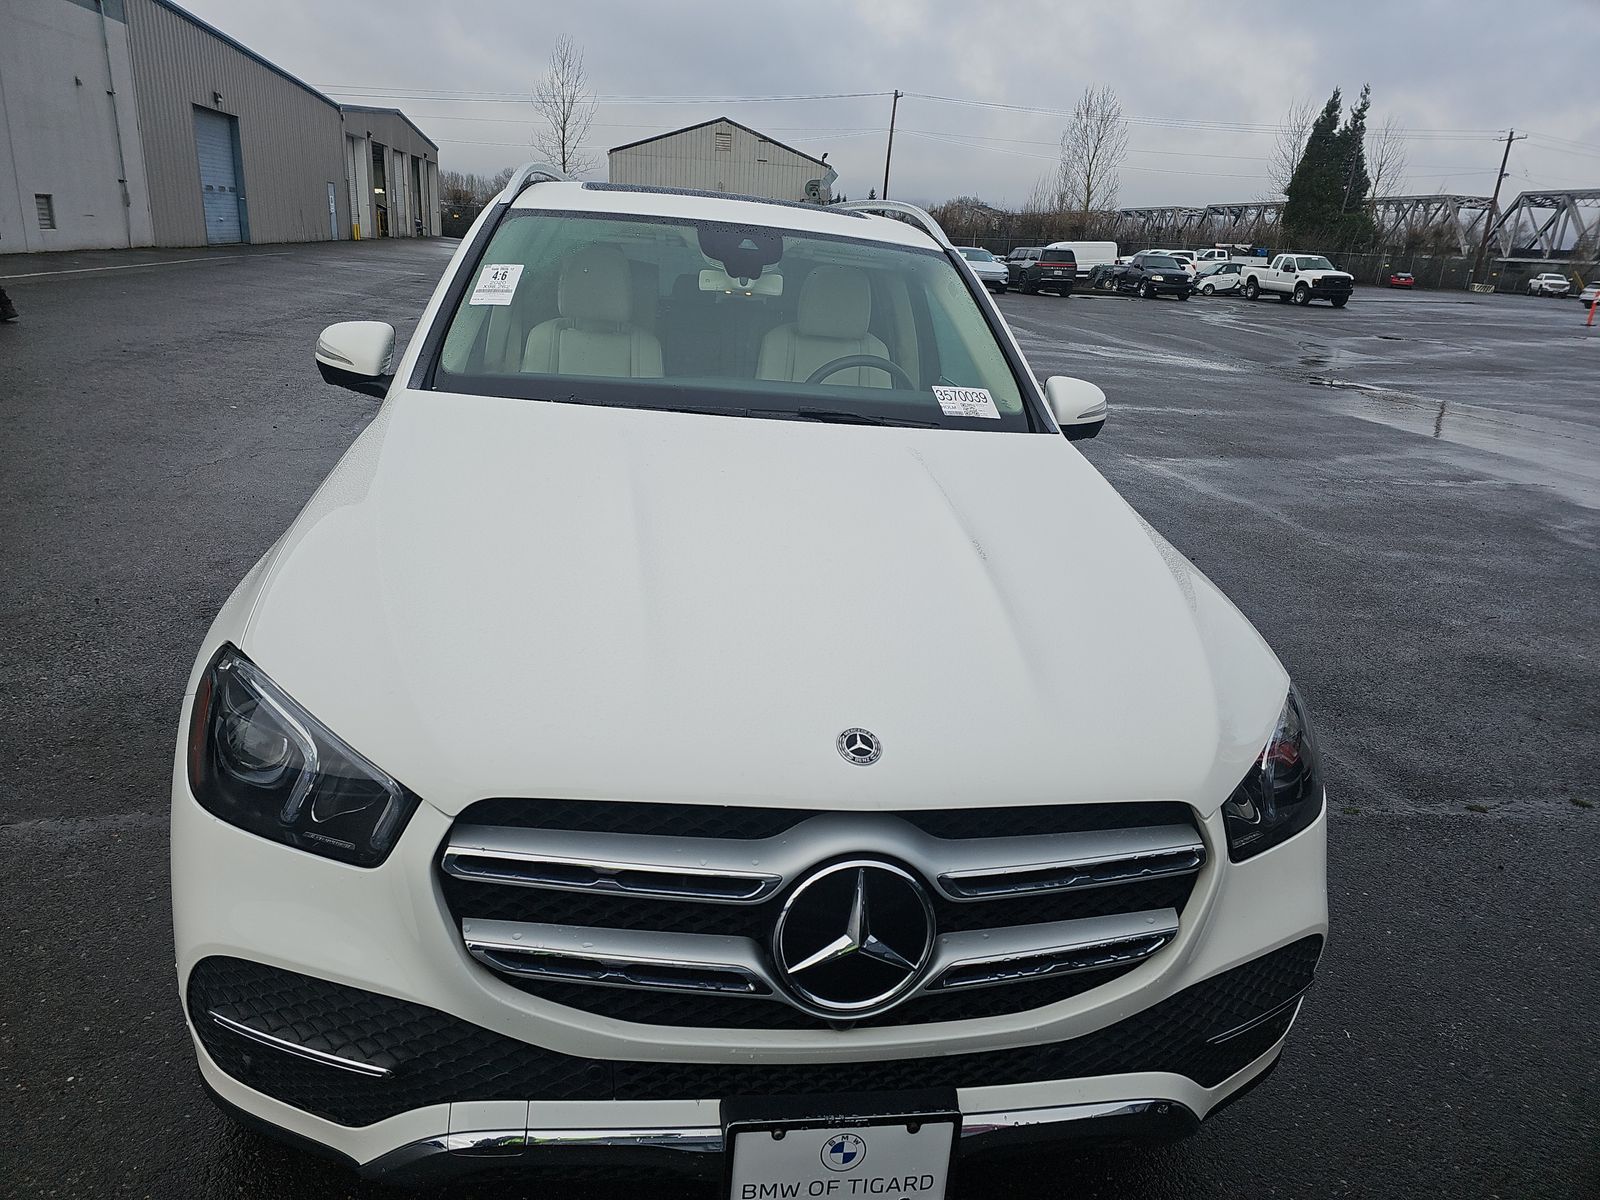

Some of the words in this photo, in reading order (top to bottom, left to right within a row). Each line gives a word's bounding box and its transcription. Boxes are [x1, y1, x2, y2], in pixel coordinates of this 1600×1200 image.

[492, 271, 508, 281] 4:6
[935, 389, 988, 404] 3570039
[828, 1135, 861, 1147] BMW
[742, 1182, 800, 1200] BMW
[808, 1180, 840, 1197] OF
[847, 1174, 934, 1194] TIGARD
